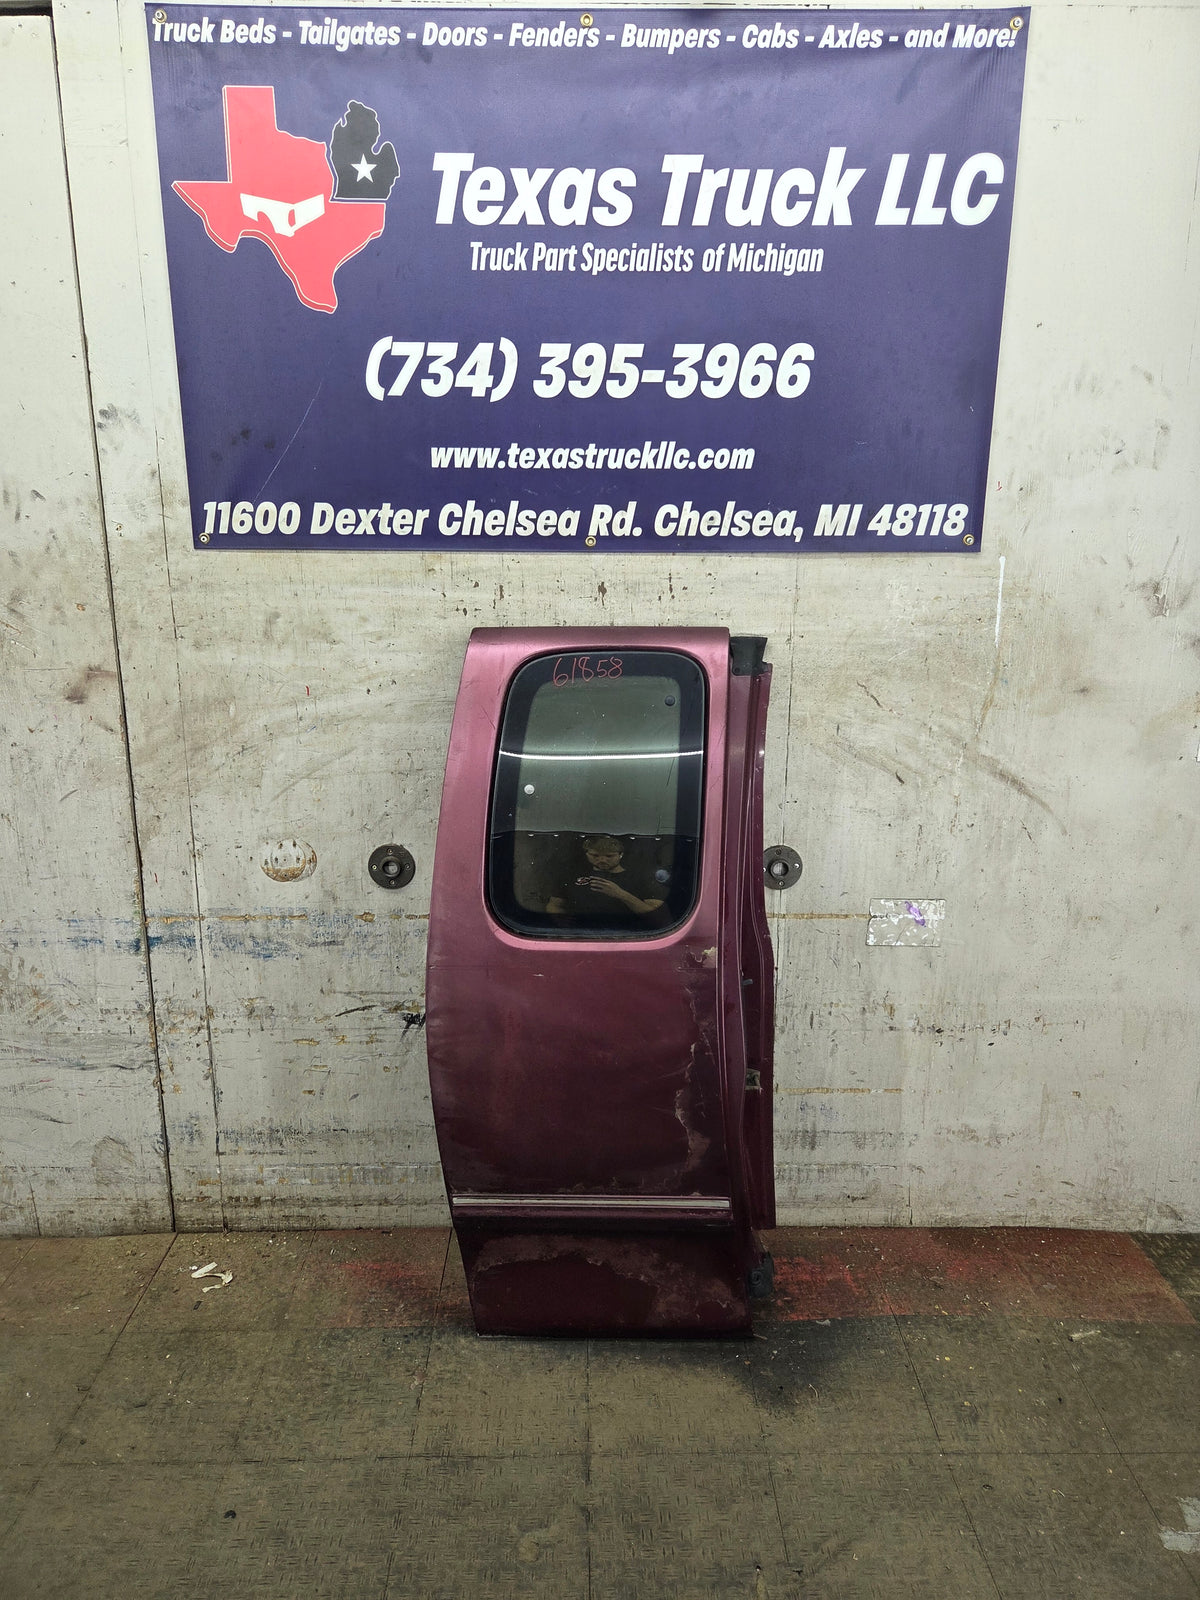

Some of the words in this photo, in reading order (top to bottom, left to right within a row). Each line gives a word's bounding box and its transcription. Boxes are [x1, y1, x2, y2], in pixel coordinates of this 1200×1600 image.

[152, 17, 215, 42] Truck
[219, 17, 276, 44] Beds
[299, 18, 400, 52] Tailgates
[422, 22, 488, 46] Doors
[508, 21, 600, 48] Fenders
[620, 23, 721, 54] Bumpers
[742, 22, 799, 48] Cabs
[818, 22, 883, 48] Axles
[904, 22, 950, 48] and
[952, 24, 1017, 48] More!
[432, 152, 637, 226] Texas
[660, 146, 867, 226] Truck
[874, 152, 1005, 226] LLC
[470, 241, 529, 271] Truck
[532, 242, 577, 271] Part
[580, 242, 694, 275] Specialists
[702, 243, 725, 272] of
[727, 242, 824, 276] Michigan
[366, 336, 518, 402] (734)
[533, 342, 815, 399] 395-3966
[430, 441, 755, 469] www.texastruckllc.com
[203, 502, 301, 535] 11600
[311, 502, 429, 535] Dexter
[438, 500, 580, 536] Chelsea
[588, 501, 642, 537] Rd.
[654, 501, 803, 542] Chelsea,
[813, 503, 863, 536] MI
[867, 503, 969, 537] 48118
[553, 656, 623, 687] 61858
